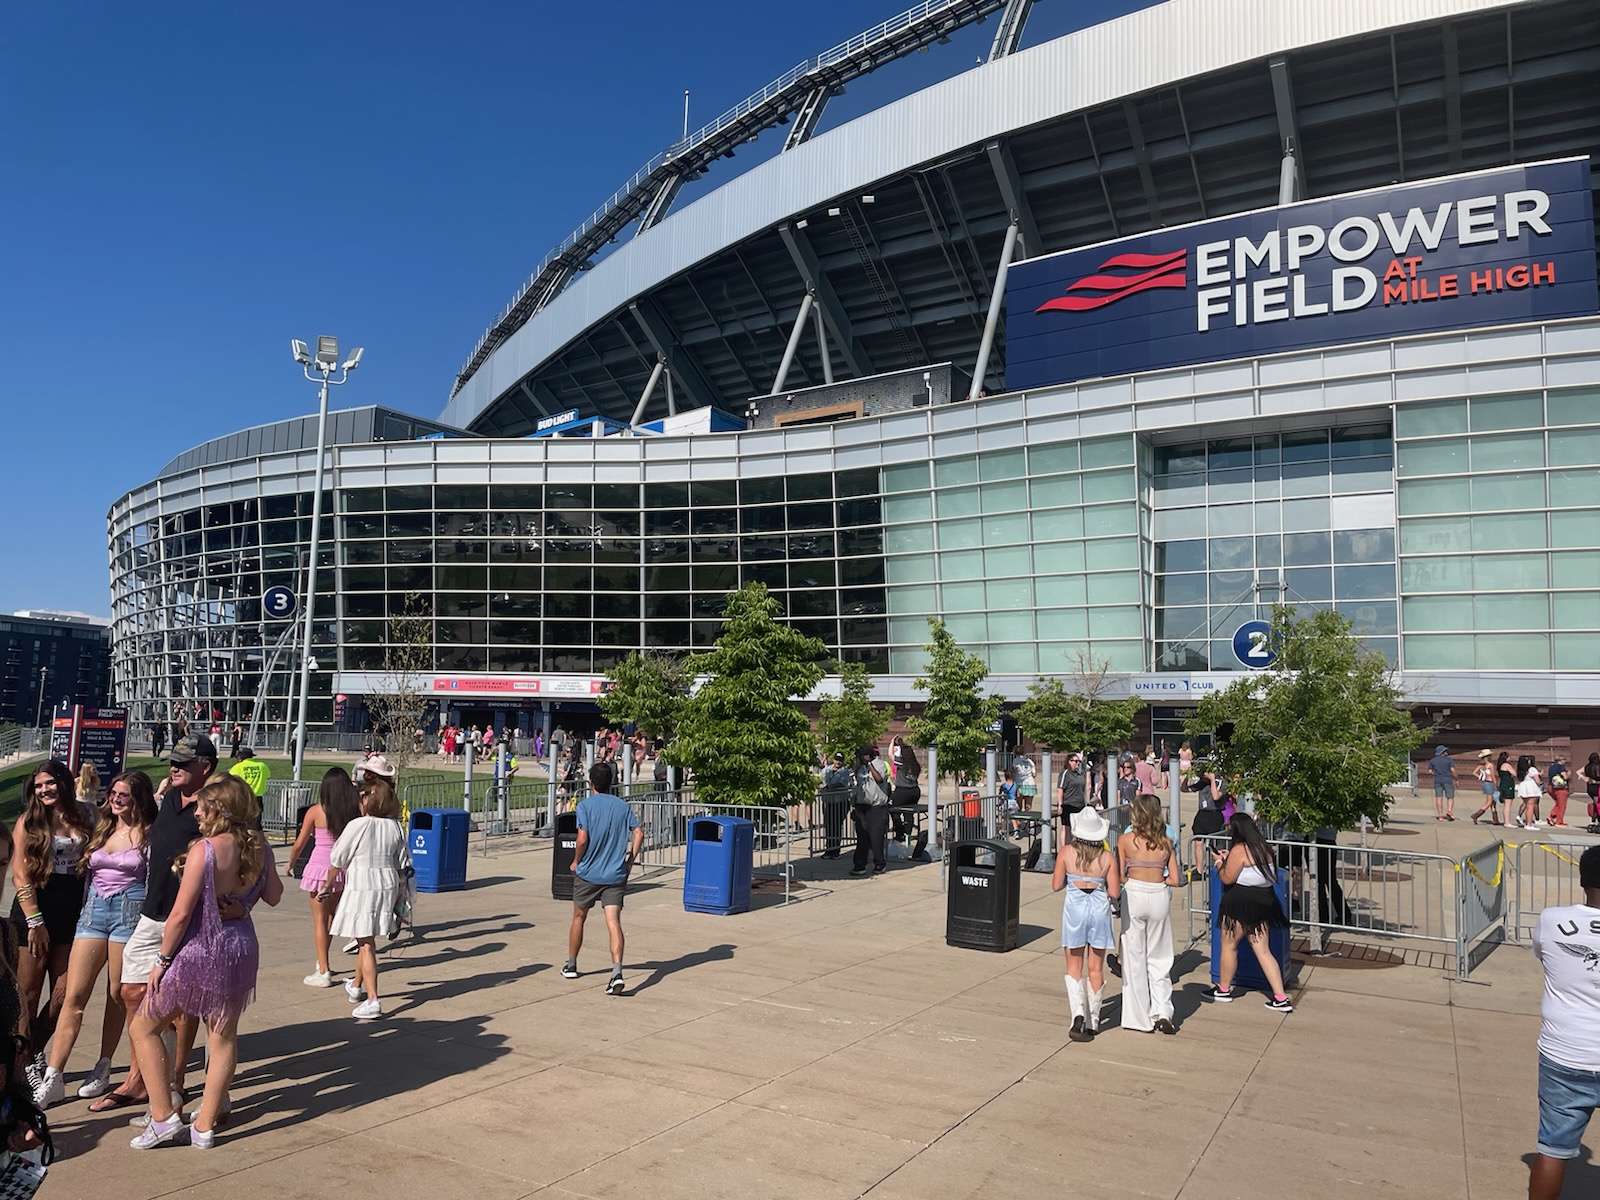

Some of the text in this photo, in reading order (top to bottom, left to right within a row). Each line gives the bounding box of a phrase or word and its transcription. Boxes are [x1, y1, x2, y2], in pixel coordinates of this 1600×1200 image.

[1196, 189, 1553, 286] EMPOWER
[1382, 256, 1423, 282] AT
[1383, 261, 1556, 306] MILE HIGH
[1197, 266, 1378, 332] FIELD
[538, 411, 575, 430] BUD LIGHT
[274, 593, 288, 610] 3
[1247, 631, 1269, 658] 2
[1135, 682, 1214, 690] UNITED CLUB
[62, 700, 68, 710] 2
[962, 876, 988, 887] WASTE
